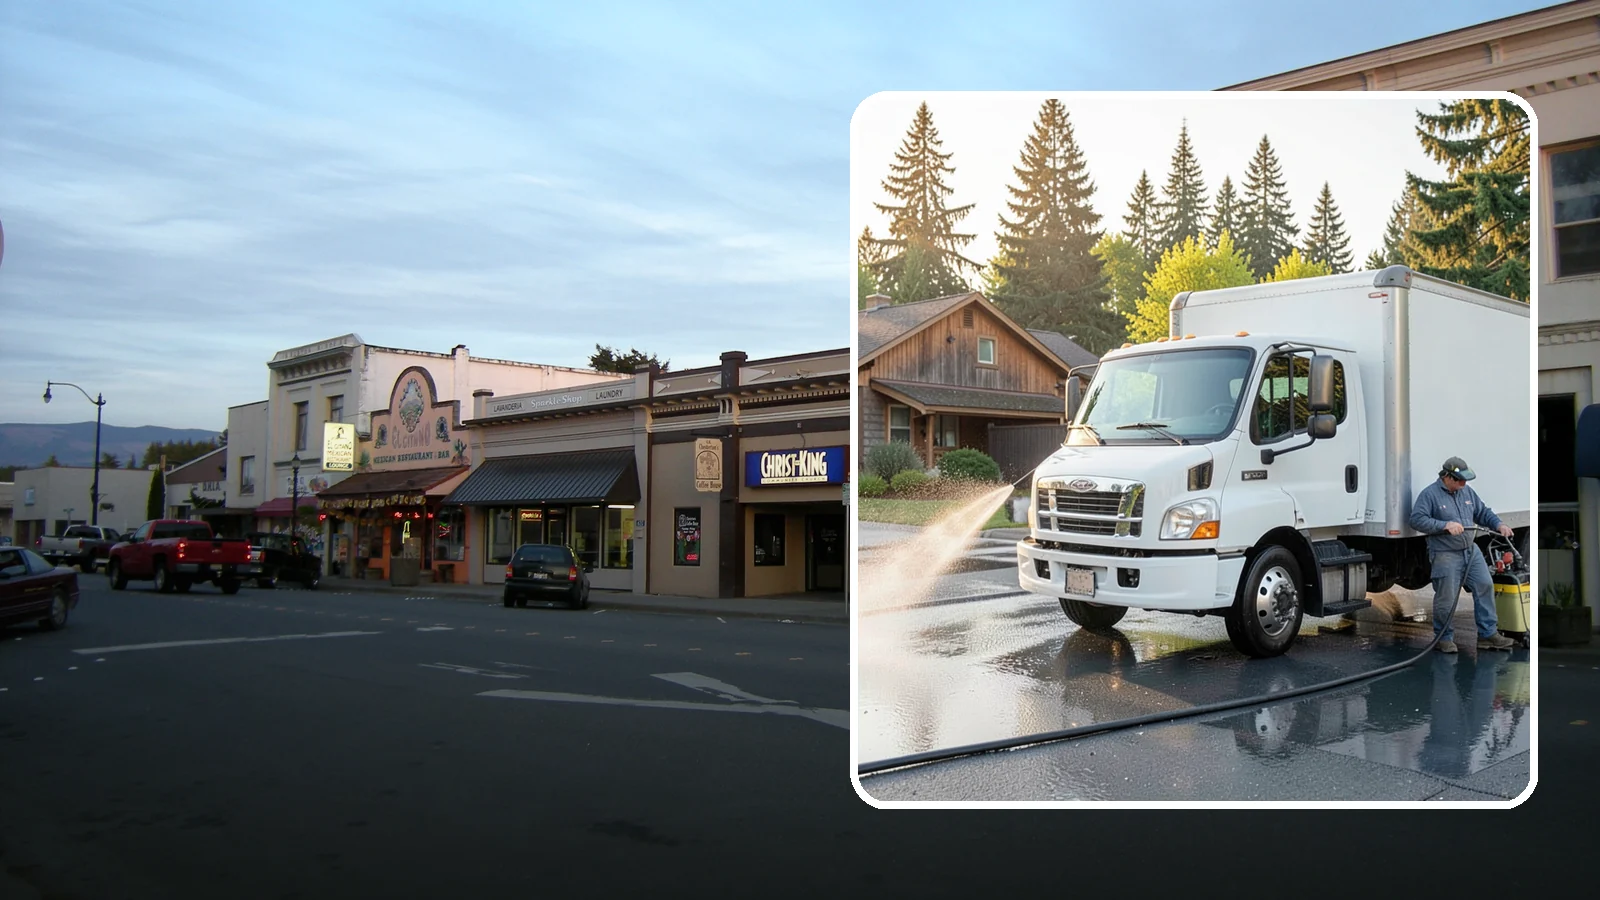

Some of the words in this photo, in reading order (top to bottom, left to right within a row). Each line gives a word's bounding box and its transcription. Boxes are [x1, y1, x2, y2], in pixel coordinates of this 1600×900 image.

[595, 388, 623, 400] LAUNDRY
[493, 401, 523, 413] LAVANDERIA
[530, 398, 561, 409] Sparkle
[561, 394, 582, 405] Shop
[373, 454, 396, 464] MEXICAN
[397, 451, 433, 462] RESTAURANT
[437, 450, 450, 459] BAR
[760, 451, 798, 478] CHRIST
[799, 450, 827, 476] KING
